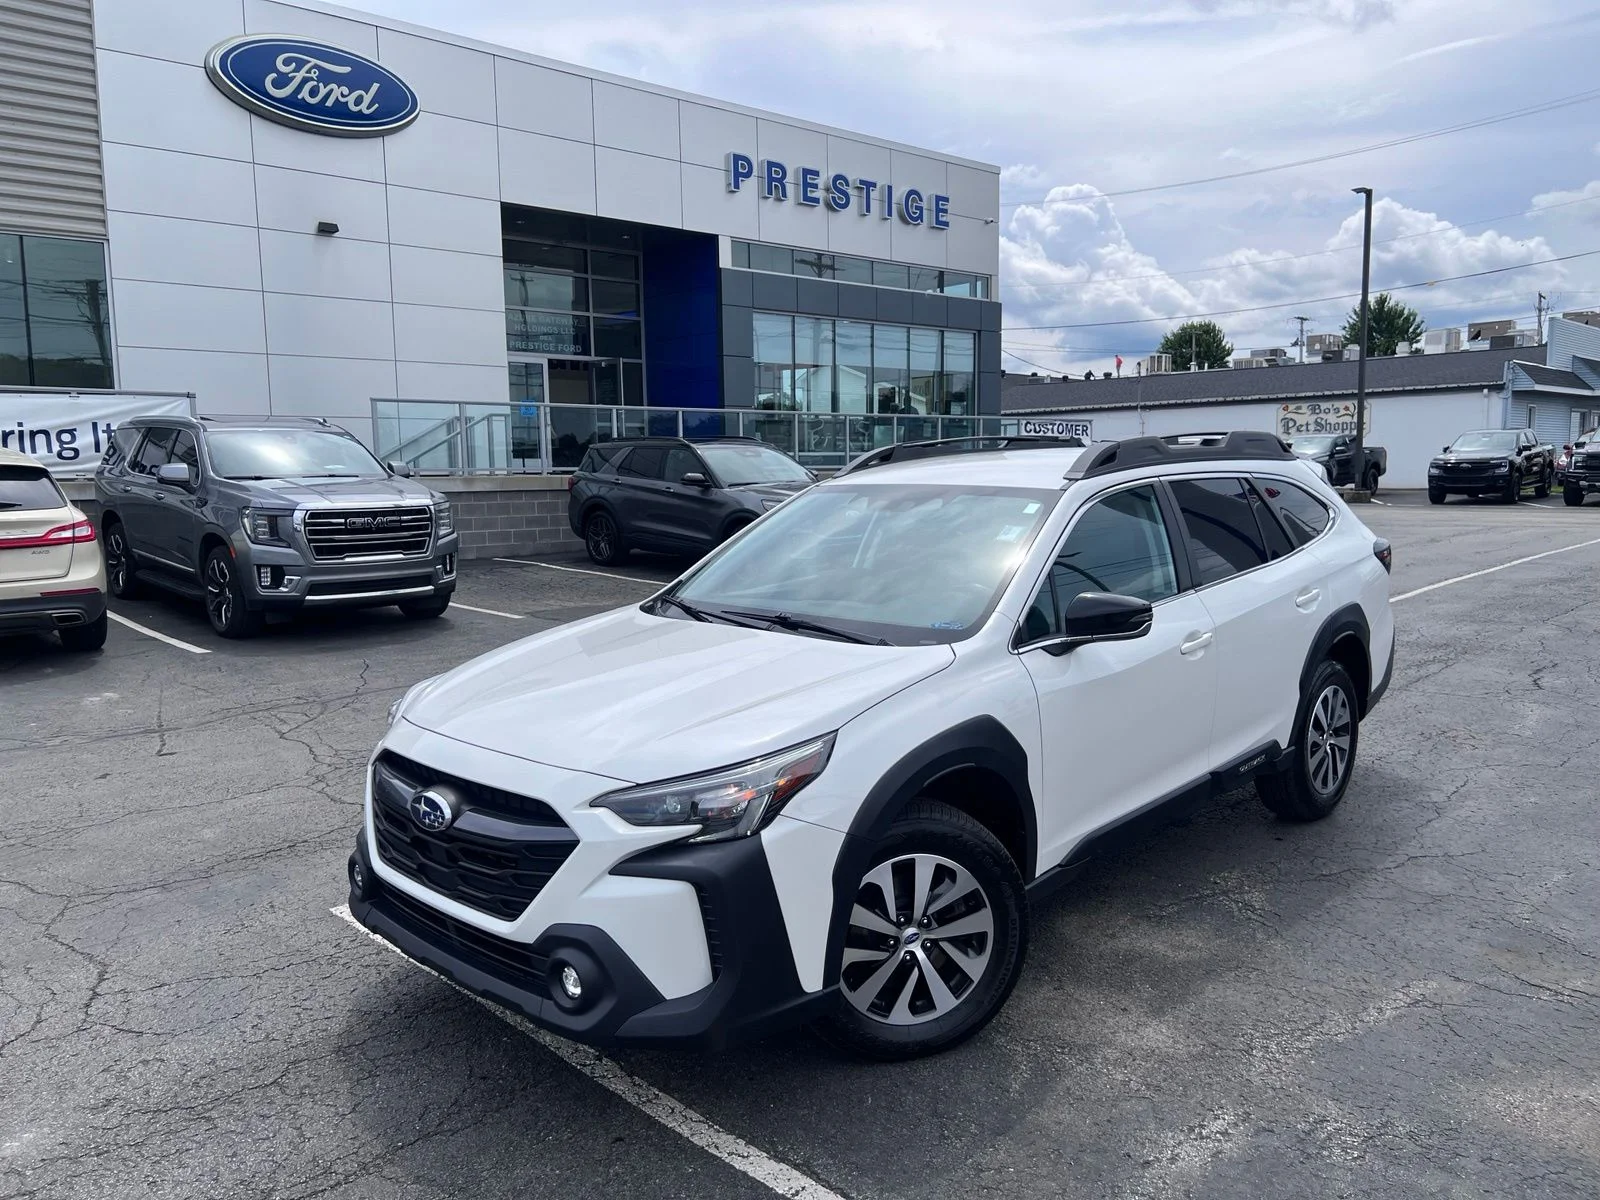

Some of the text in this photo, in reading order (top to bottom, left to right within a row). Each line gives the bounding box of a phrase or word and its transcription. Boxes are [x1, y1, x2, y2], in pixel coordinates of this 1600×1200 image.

[264, 53, 381, 115] Ford
[727, 152, 950, 230] PRESTIGE
[509, 340, 582, 352] PRESTIGE FORD
[1307, 403, 1340, 416] Bo's
[1024, 421, 1089, 437] CUSTOMER
[1281, 416, 1366, 435] Pet Shopp
[347, 516, 401, 529] GMC
